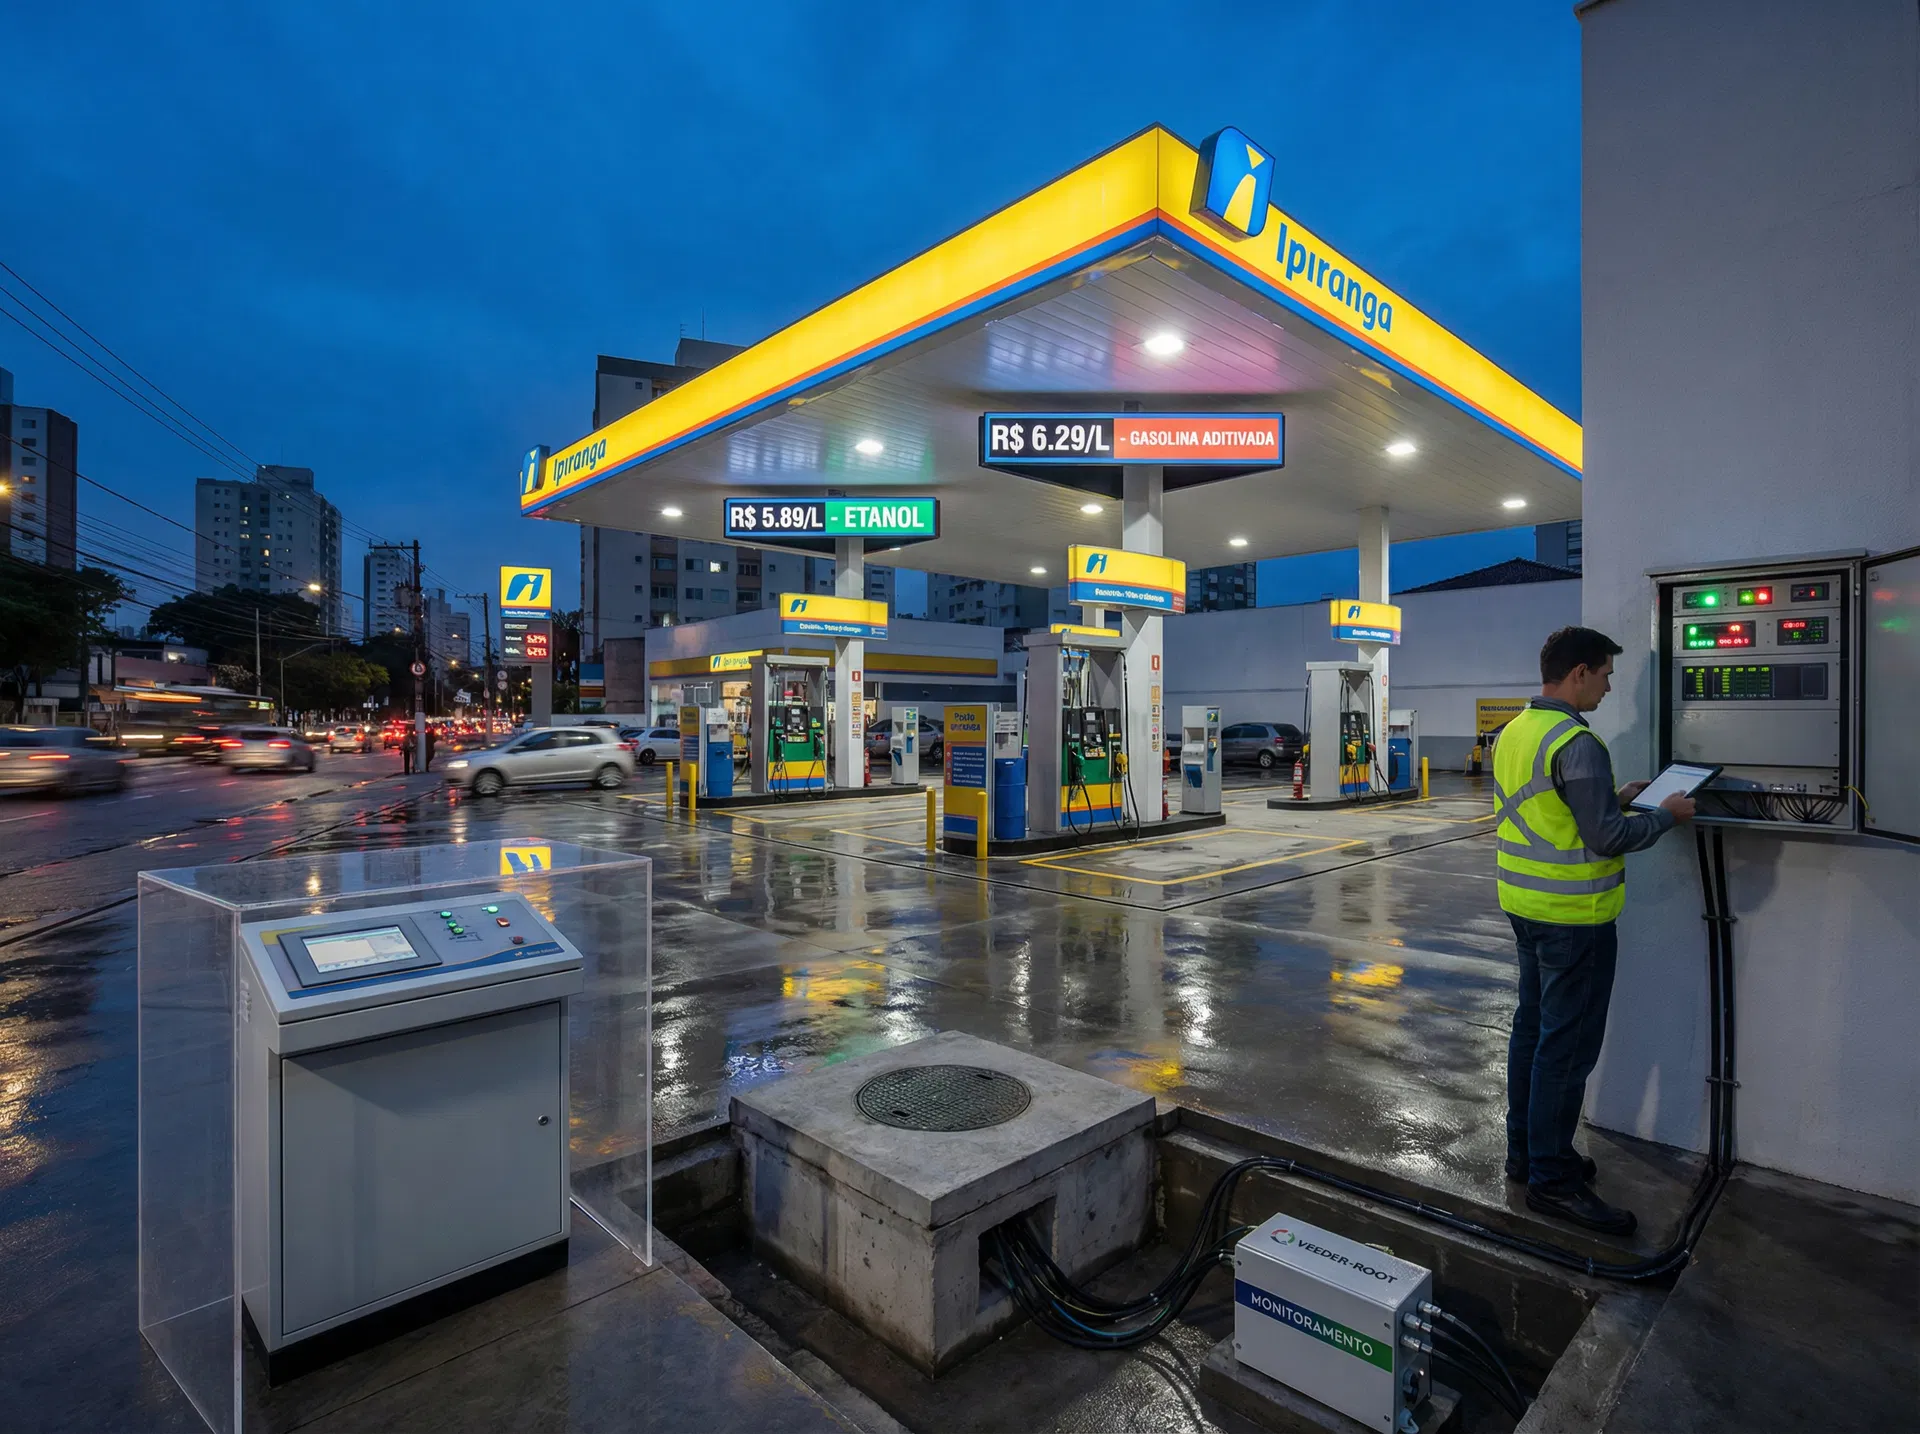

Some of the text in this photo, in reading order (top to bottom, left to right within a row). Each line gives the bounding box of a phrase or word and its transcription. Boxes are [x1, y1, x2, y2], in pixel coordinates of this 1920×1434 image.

[1276, 222, 1393, 333] Ipiranga
[992, 423, 1025, 454] R$
[1032, 424, 1110, 454] 6.29/L
[1130, 431, 1199, 446] GASOLINA
[1202, 431, 1275, 446] ADITIVADA
[553, 438, 606, 487] Ipiranga
[731, 505, 757, 530] R$
[762, 506, 823, 530] 5.89/L
[844, 506, 925, 528] ETANOL
[1298, 1239, 1398, 1284] VEEDER-ROOT
[1251, 1292, 1374, 1357] MONITORAMENTO
